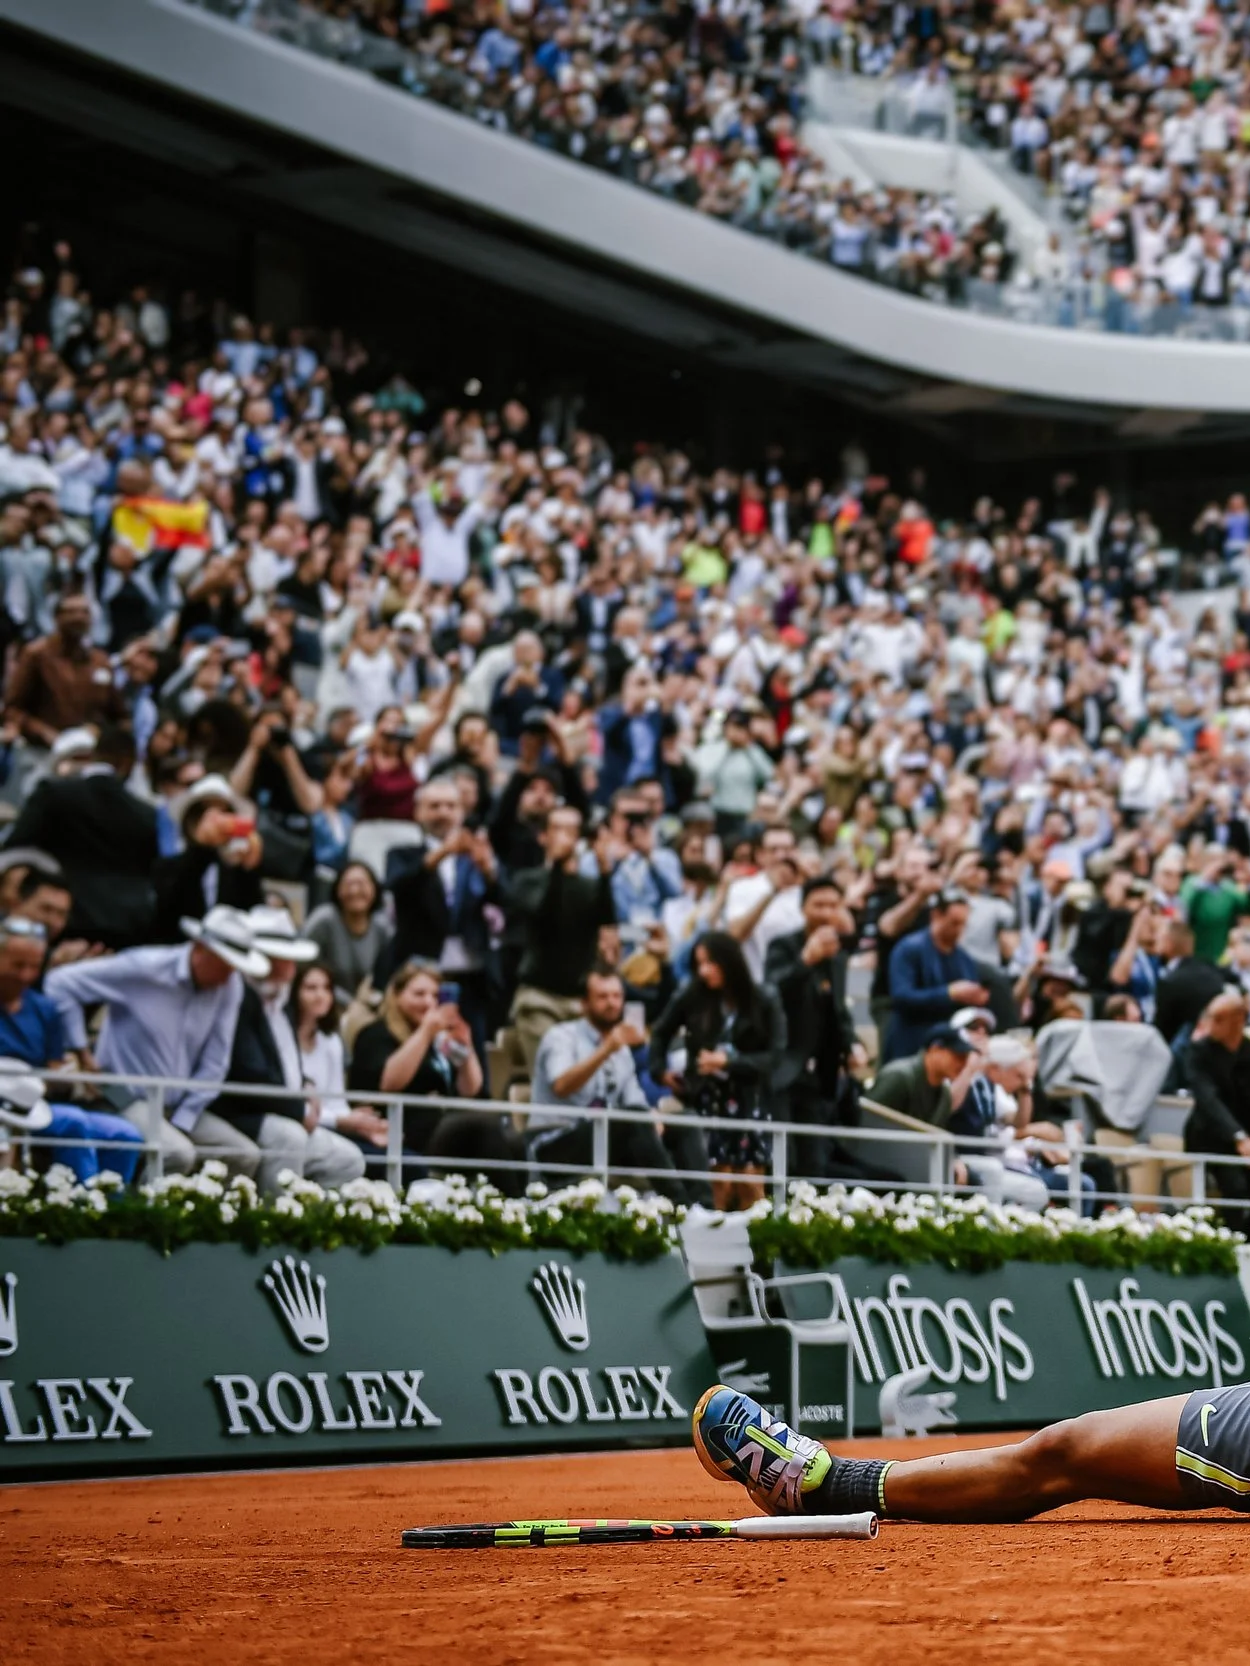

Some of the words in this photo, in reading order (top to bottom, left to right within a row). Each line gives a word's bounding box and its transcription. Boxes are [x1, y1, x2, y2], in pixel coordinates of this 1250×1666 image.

[832, 1273, 1035, 1401] Infosys
[1072, 1277, 1246, 1388] Infosys
[212, 1369, 442, 1435] ROLEX
[494, 1364, 689, 1424] ROLEX
